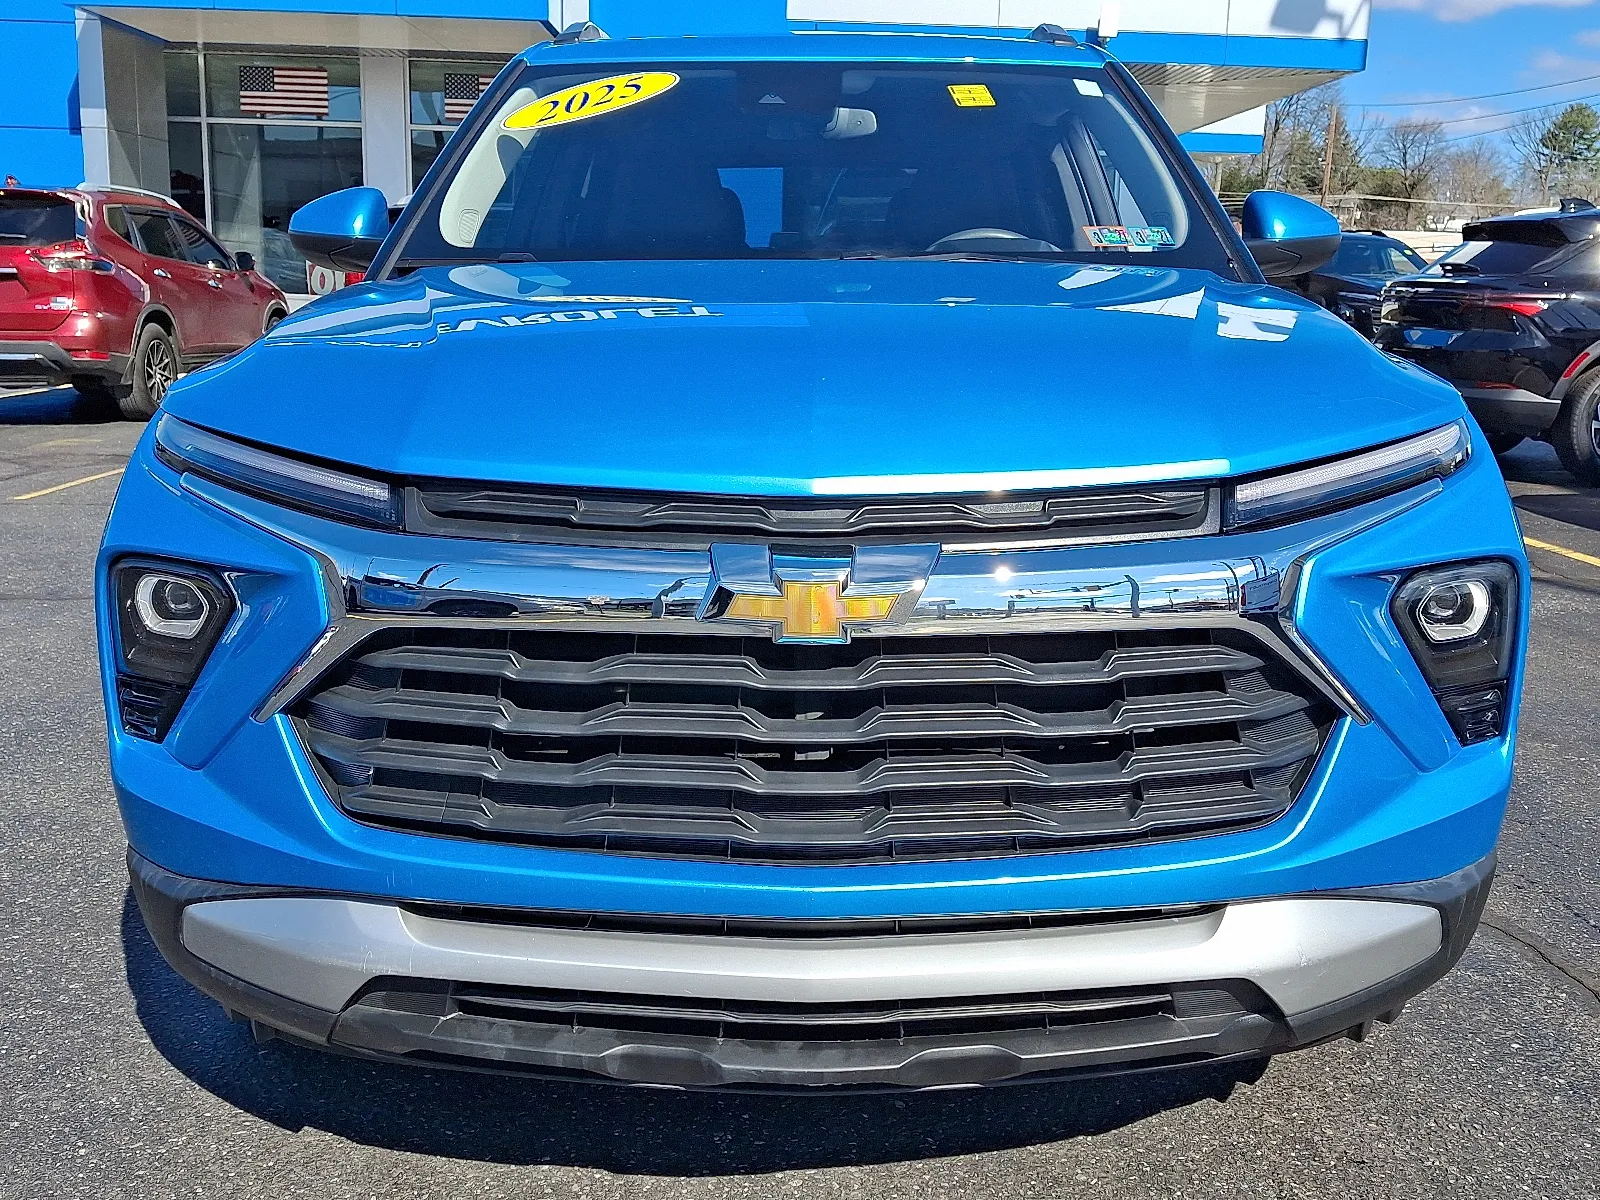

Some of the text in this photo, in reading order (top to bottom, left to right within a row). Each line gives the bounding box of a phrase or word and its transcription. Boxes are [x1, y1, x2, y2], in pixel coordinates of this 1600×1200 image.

[535, 75, 644, 125] 2025
[1093, 231, 1104, 244] 3
[1135, 231, 1146, 244] 3
